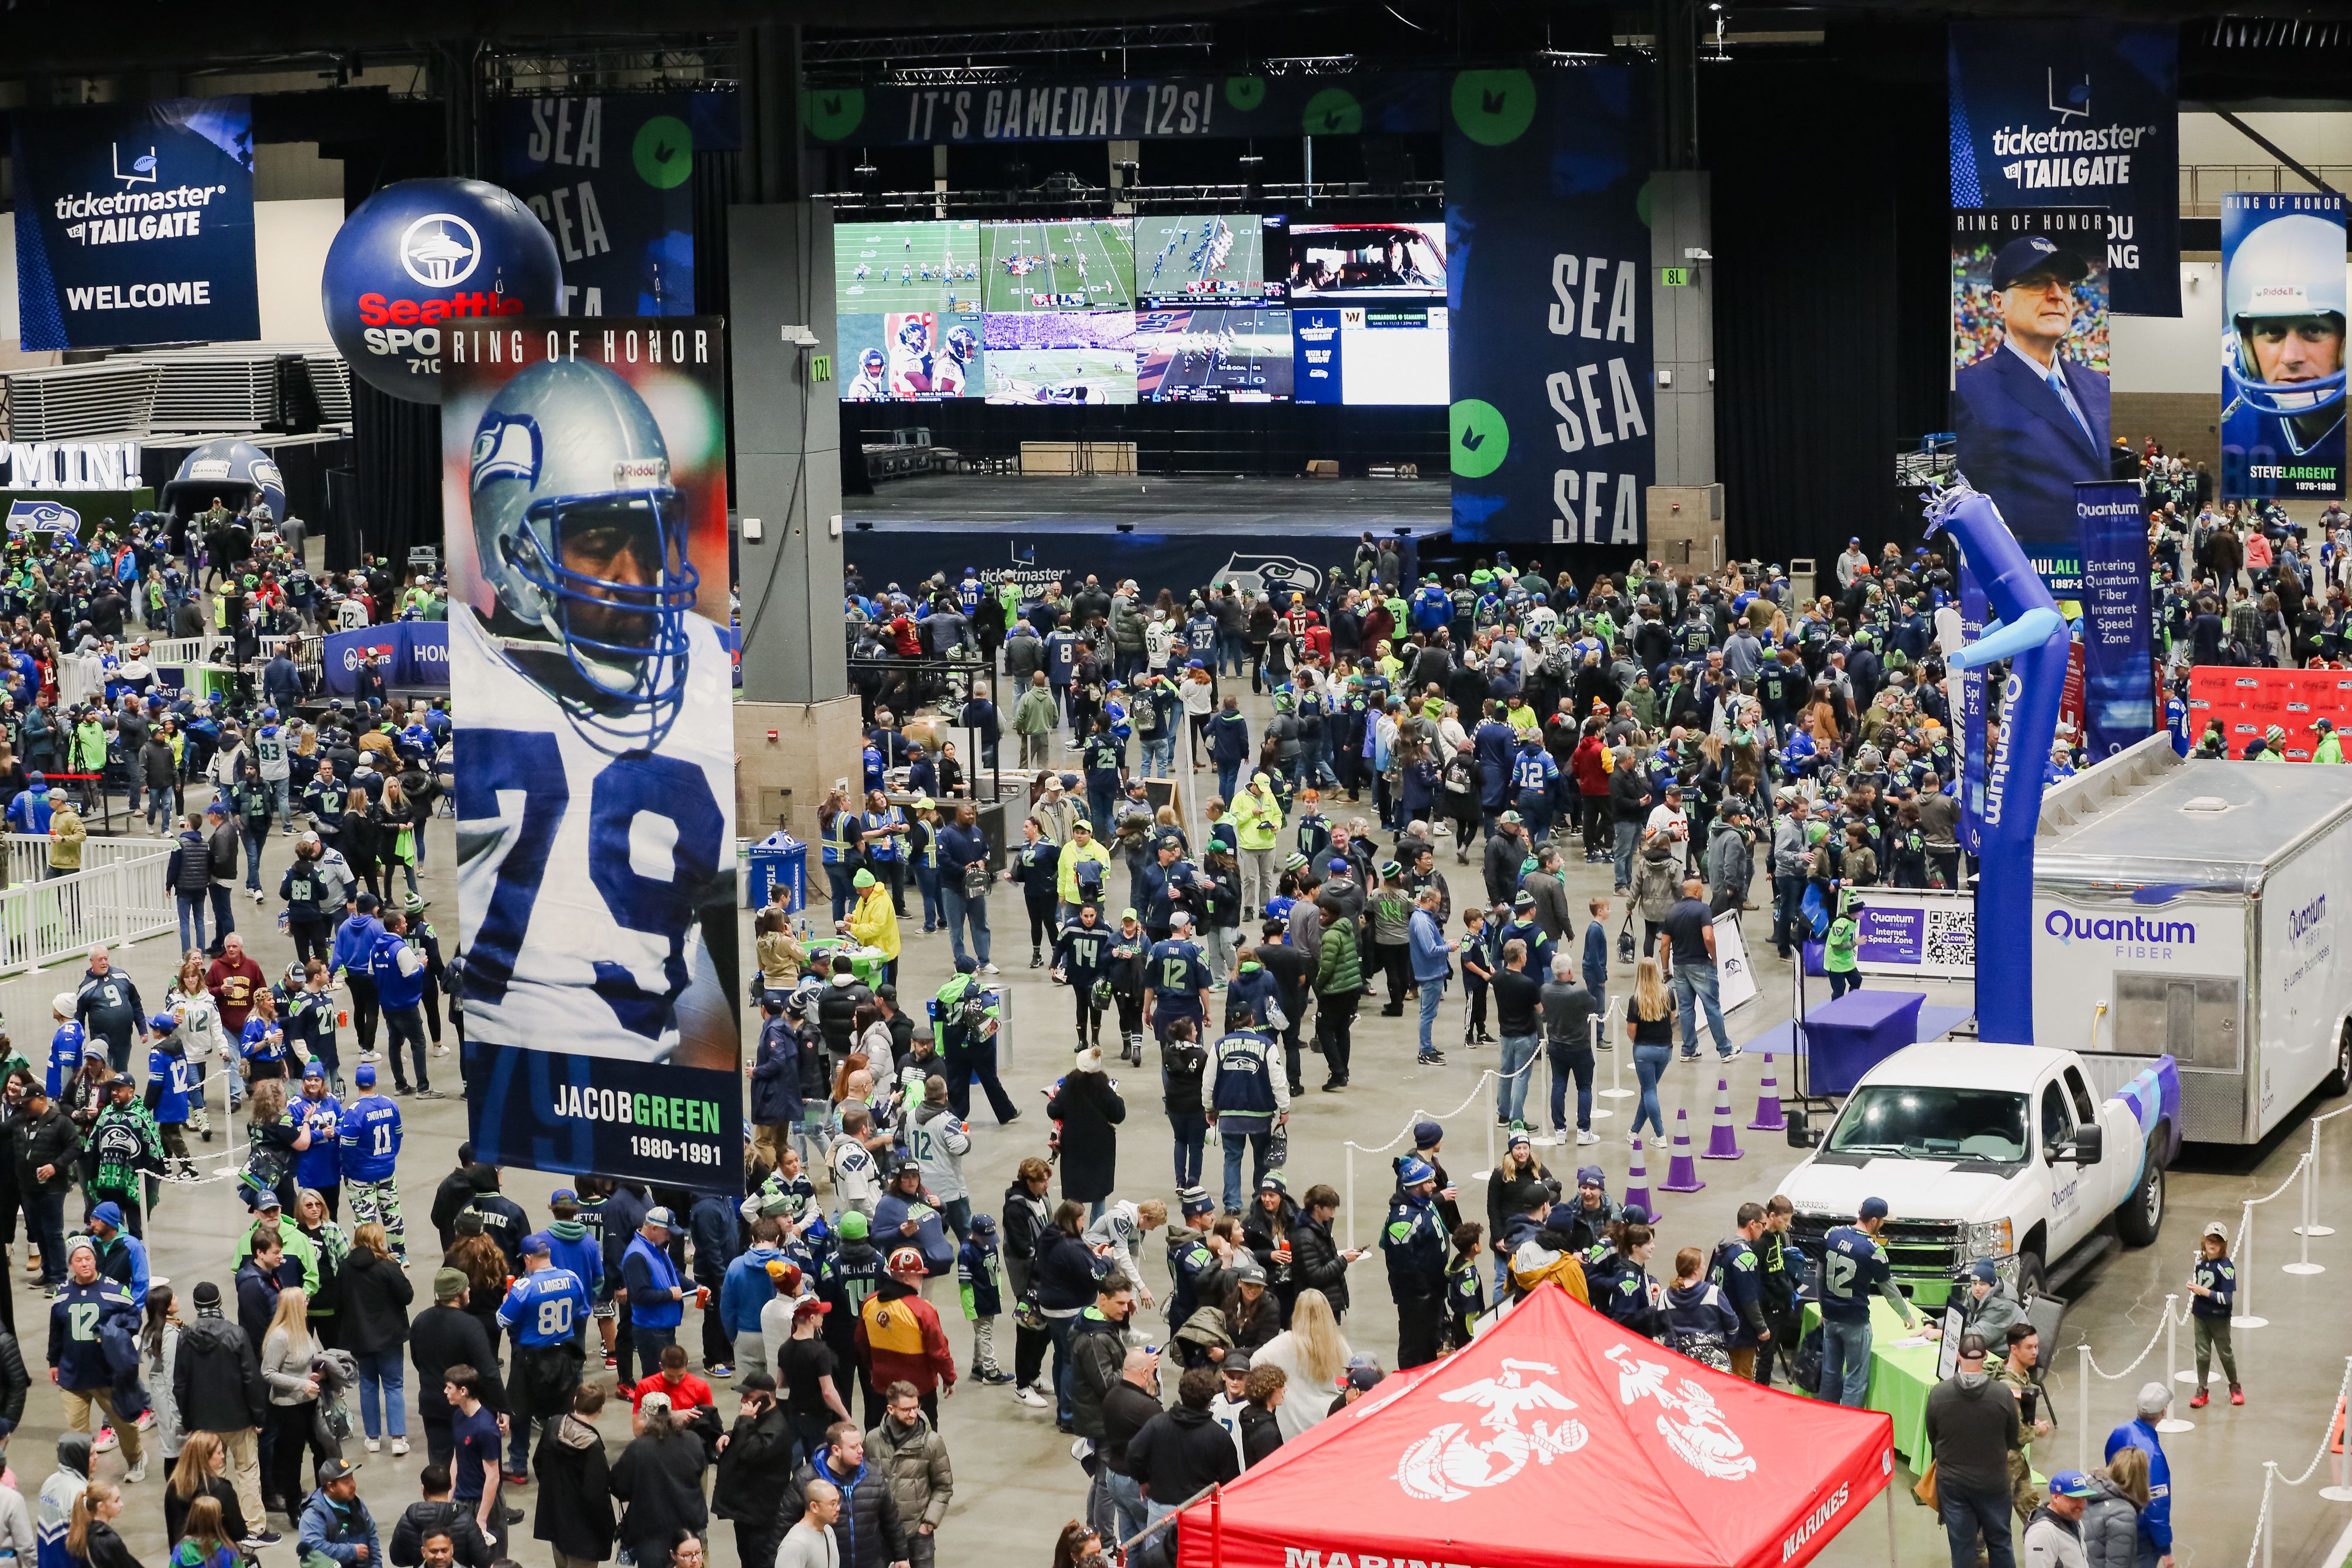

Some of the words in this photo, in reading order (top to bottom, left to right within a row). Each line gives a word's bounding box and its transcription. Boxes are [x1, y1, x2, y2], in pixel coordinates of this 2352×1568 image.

[908, 90, 970, 141] IT'S
[983, 85, 1130, 139] GAMEDAY
[1144, 83, 1214, 136] 12s!
[529, 97, 602, 168] SEA
[2024, 155, 2130, 189] TAILGATE
[2227, 196, 2260, 210] RING
[2269, 196, 2284, 210] OF
[2294, 197, 2341, 210] HONOR
[89, 210, 201, 245] TAILGATE
[1957, 215, 1999, 231] RING
[2012, 215, 2030, 230] OF
[2043, 214, 2103, 230] HONOR
[2107, 215, 2133, 240] OU
[2107, 244, 2140, 269] NG
[1668, 269, 1681, 285] 8L
[67, 281, 211, 310] WELCOME
[1548, 253, 1635, 343] SEA
[2263, 287, 2294, 296] Riddell
[365, 328, 441, 355] SPO
[454, 330, 524, 363] RING
[547, 330, 579, 363] OF
[603, 329, 709, 363] HONOR
[814, 358, 830, 381] 12L
[1546, 356, 1648, 454] SEA
[2186, 479, 2197, 492] 54
[2296, 482, 2336, 491] 1976-1989
[1552, 469, 1638, 545] SEA
[2077, 502, 2140, 519] Quantum
[2030, 559, 2082, 574] AULALL
[2087, 560, 2136, 576] Entering
[2050, 579, 2083, 589] 1997-2
[2086, 575, 2139, 588] Quantum
[963, 592, 977, 604] 10
[2099, 589, 2127, 600] Fiber
[1392, 609, 1401, 624] 3
[2092, 603, 2137, 616] Internet
[342, 612, 354, 628] 12
[1293, 619, 1306, 635] 17
[1541, 620, 1555, 634] 27
[2097, 618, 2133, 633] Speed
[1192, 630, 1214, 650] 37
[1688, 633, 1709, 651] 54
[1873, 637, 1883, 655] 12
[2102, 633, 2130, 644] Zone
[415, 645, 449, 662] HOM
[1060, 643, 1072, 663] 8
[44, 667, 53, 685] 17
[1768, 680, 1782, 700] 19
[260, 743, 280, 761] 83
[1097, 748, 1117, 768] 25
[1984, 673, 2022, 824] Quantum
[1519, 762, 1544, 788] 12
[320, 792, 339, 813] 12
[1301, 828, 1314, 853] 14
[1022, 850, 1036, 867] 12
[292, 880, 311, 900] 89
[1279, 908, 1287, 916] FAN
[1379, 900, 1403, 922] 14
[1870, 912, 1914, 924] Quantum
[2289, 893, 2326, 944] Quantum
[1876, 927, 1907, 937] Internet
[1942, 932, 1966, 942] Q.com
[2045, 910, 2195, 945] Quantum
[1868, 935, 1892, 944] Speed
[1894, 936, 1913, 944] Zone
[2305, 927, 2320, 950] FIBER
[1073, 938, 1098, 968] 14
[1168, 947, 1180, 955] FAN
[2116, 946, 2172, 959] FIBER
[2304, 944, 2330, 973] Technologies
[1163, 958, 1187, 989] 12
[103, 984, 123, 1007] 9
[186, 1008, 208, 1032] 12
[316, 1002, 333, 1035] 27
[64, 1024, 75, 1034] 12
[1219, 1042, 1266, 1061] CHAMPIONS
[170, 1059, 188, 1094] 12
[373, 1123, 392, 1156] 11
[912, 1129, 933, 1161] 12
[631, 1135, 720, 1166] 1980-1991
[2052, 1179, 2078, 1209] Quantum
[1398, 1204, 1408, 1216] 9
[1837, 1239, 1853, 1253] FAN
[840, 1262, 877, 1275] METCALF
[1464, 1268, 1472, 1279] 9
[1825, 1249, 1857, 1298] 12
[539, 1276, 571, 1294] LARGENT
[2197, 1269, 2215, 1290] 12
[844, 1279, 876, 1317] 14
[68, 1302, 99, 1341] 12
[538, 1297, 573, 1336] 80
[1946, 1339, 1956, 1352] DASH
[1783, 1480, 1849, 1563] MARINES
